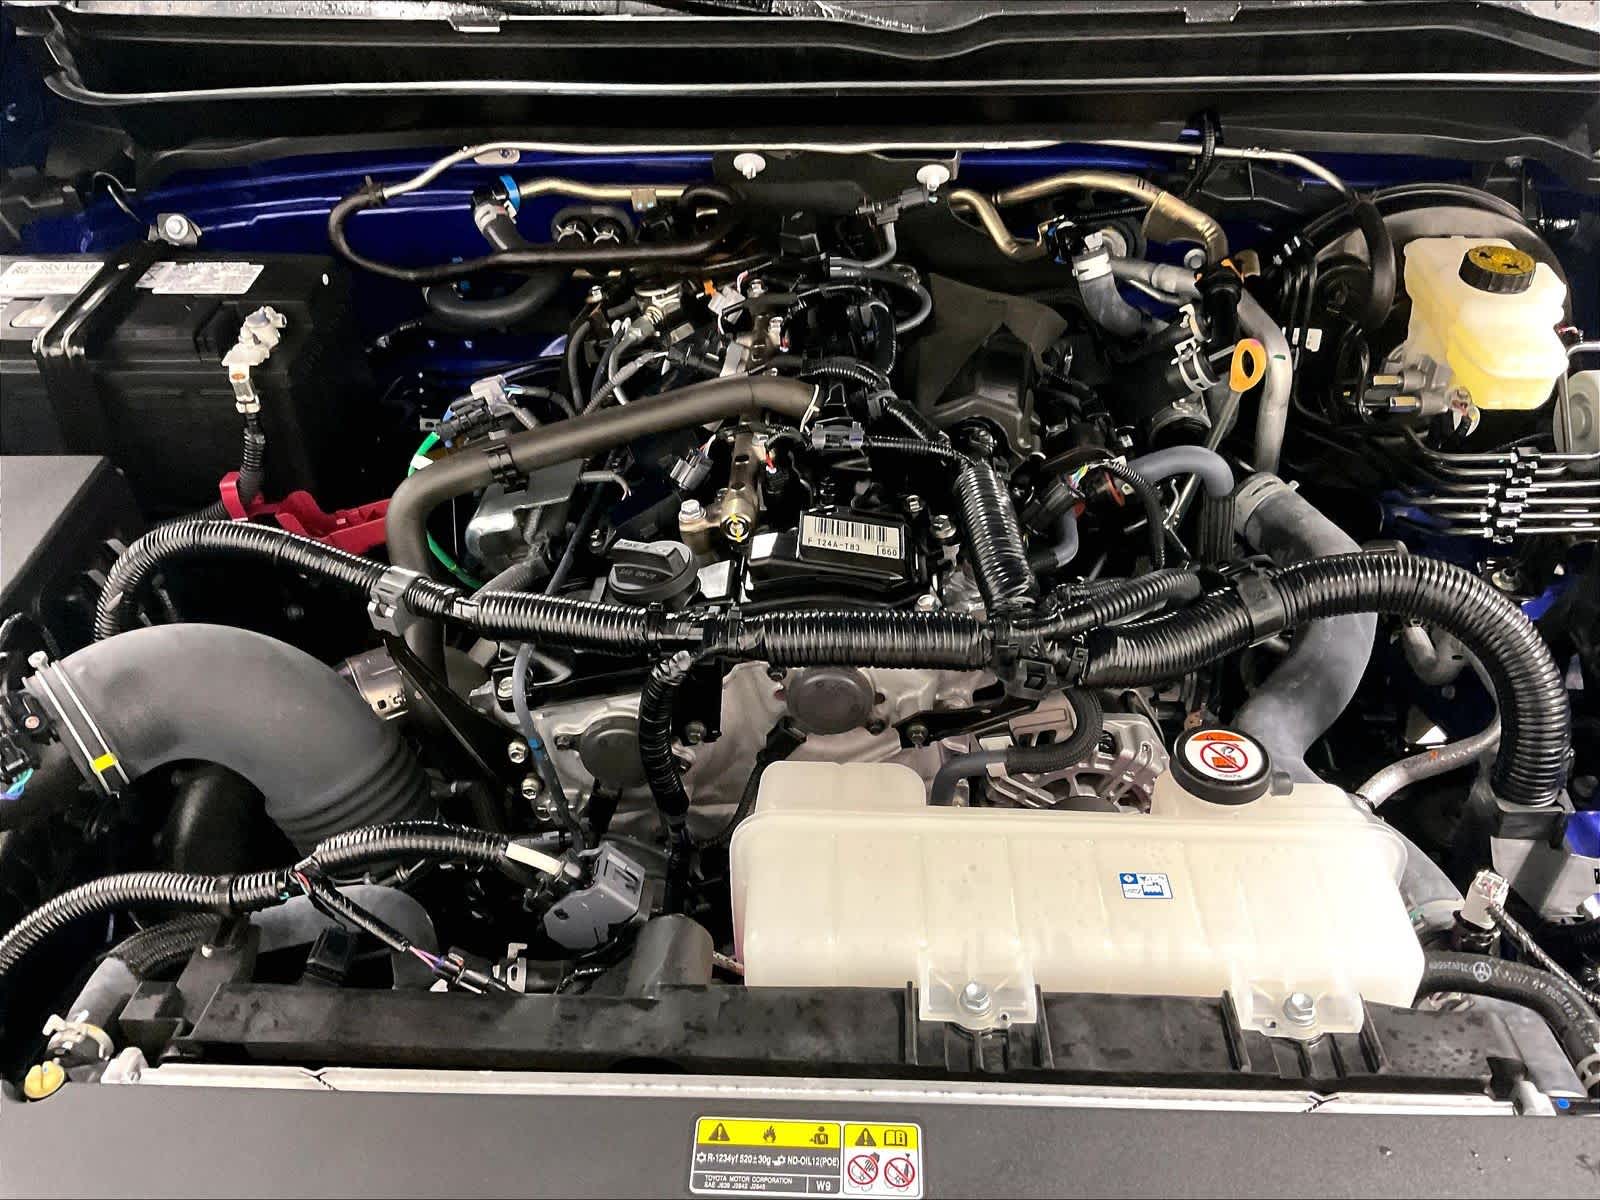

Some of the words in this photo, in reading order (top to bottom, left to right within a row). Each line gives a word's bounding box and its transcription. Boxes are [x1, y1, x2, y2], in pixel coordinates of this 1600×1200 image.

[707, 1153, 738, 1165] R-1234yf
[787, 1155, 840, 1168] ND-OIL12(POE)
[751, 1176, 793, 1184] CORPORATION
[816, 1180, 831, 1192] W9
